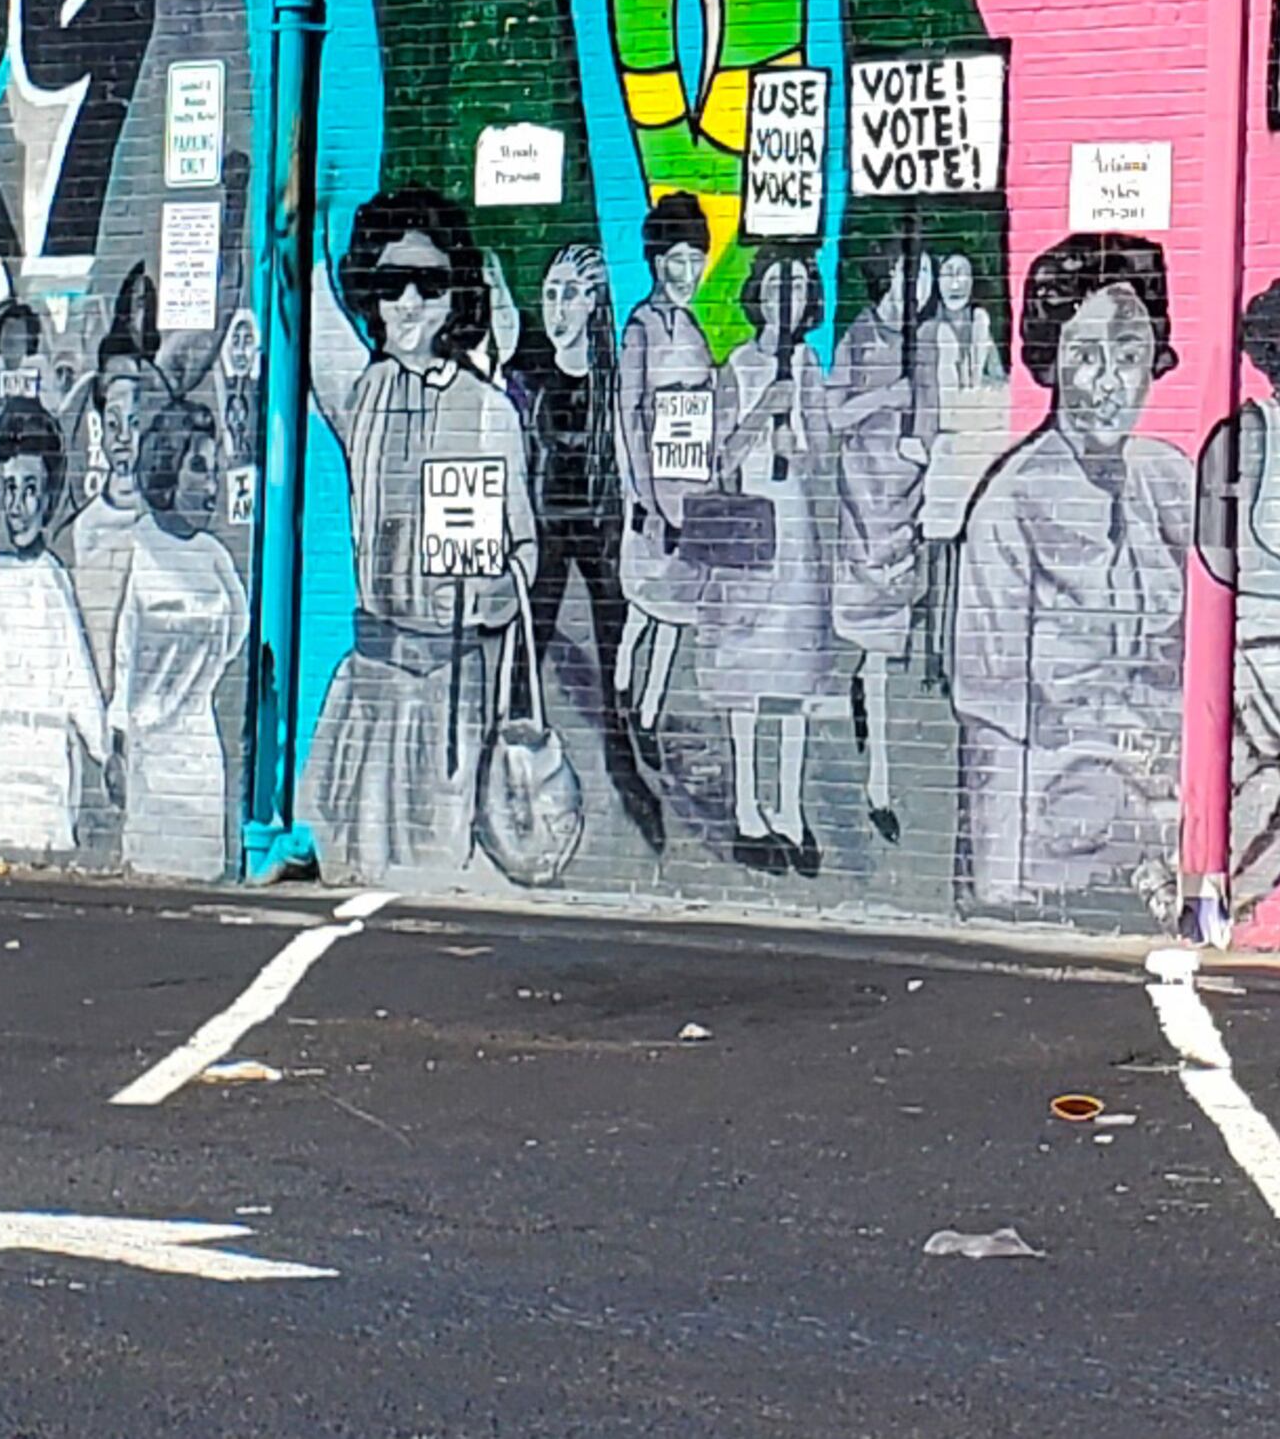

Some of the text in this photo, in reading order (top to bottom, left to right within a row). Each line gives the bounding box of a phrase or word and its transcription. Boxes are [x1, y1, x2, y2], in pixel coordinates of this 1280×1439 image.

[758, 80, 818, 118] USE
[860, 61, 966, 103] VOTE!
[751, 127, 816, 166] YOUR
[862, 105, 970, 152] VOTE!
[862, 146, 981, 190] VOTE!
[751, 171, 813, 208] VOICE
[655, 442, 712, 469] TRUTH
[428, 465, 503, 498] LOVE
[425, 534, 502, 574] POWER
